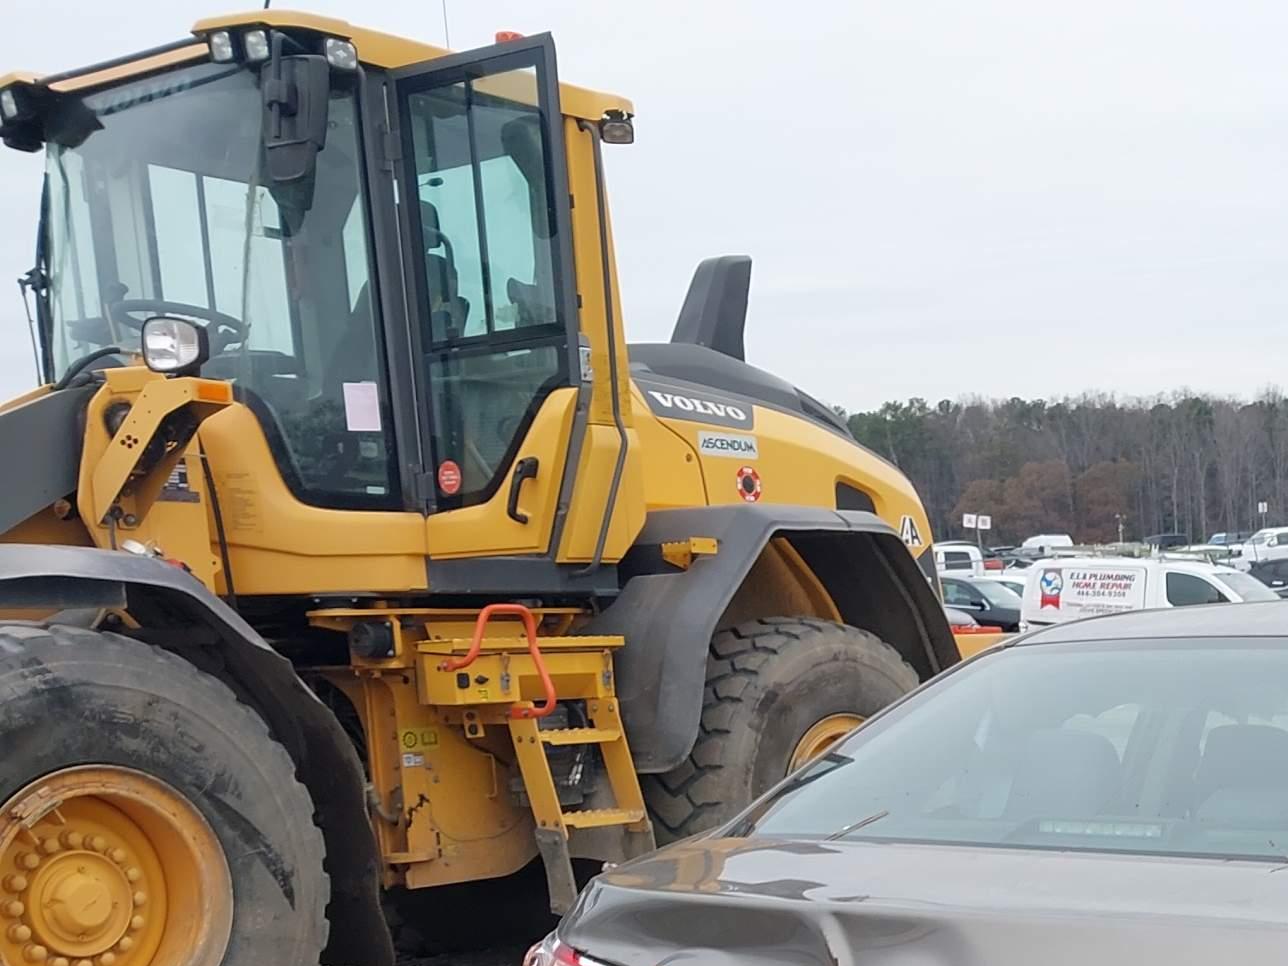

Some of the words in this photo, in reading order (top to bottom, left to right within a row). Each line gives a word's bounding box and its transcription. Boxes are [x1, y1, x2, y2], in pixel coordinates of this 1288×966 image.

[647, 390, 747, 421] VOLVO
[701, 437, 756, 453] ASCENDUM
[1088, 572, 1136, 582] PLUMBING
[1071, 581, 1097, 590] HOME
[1100, 582, 1133, 591] REPAIR
